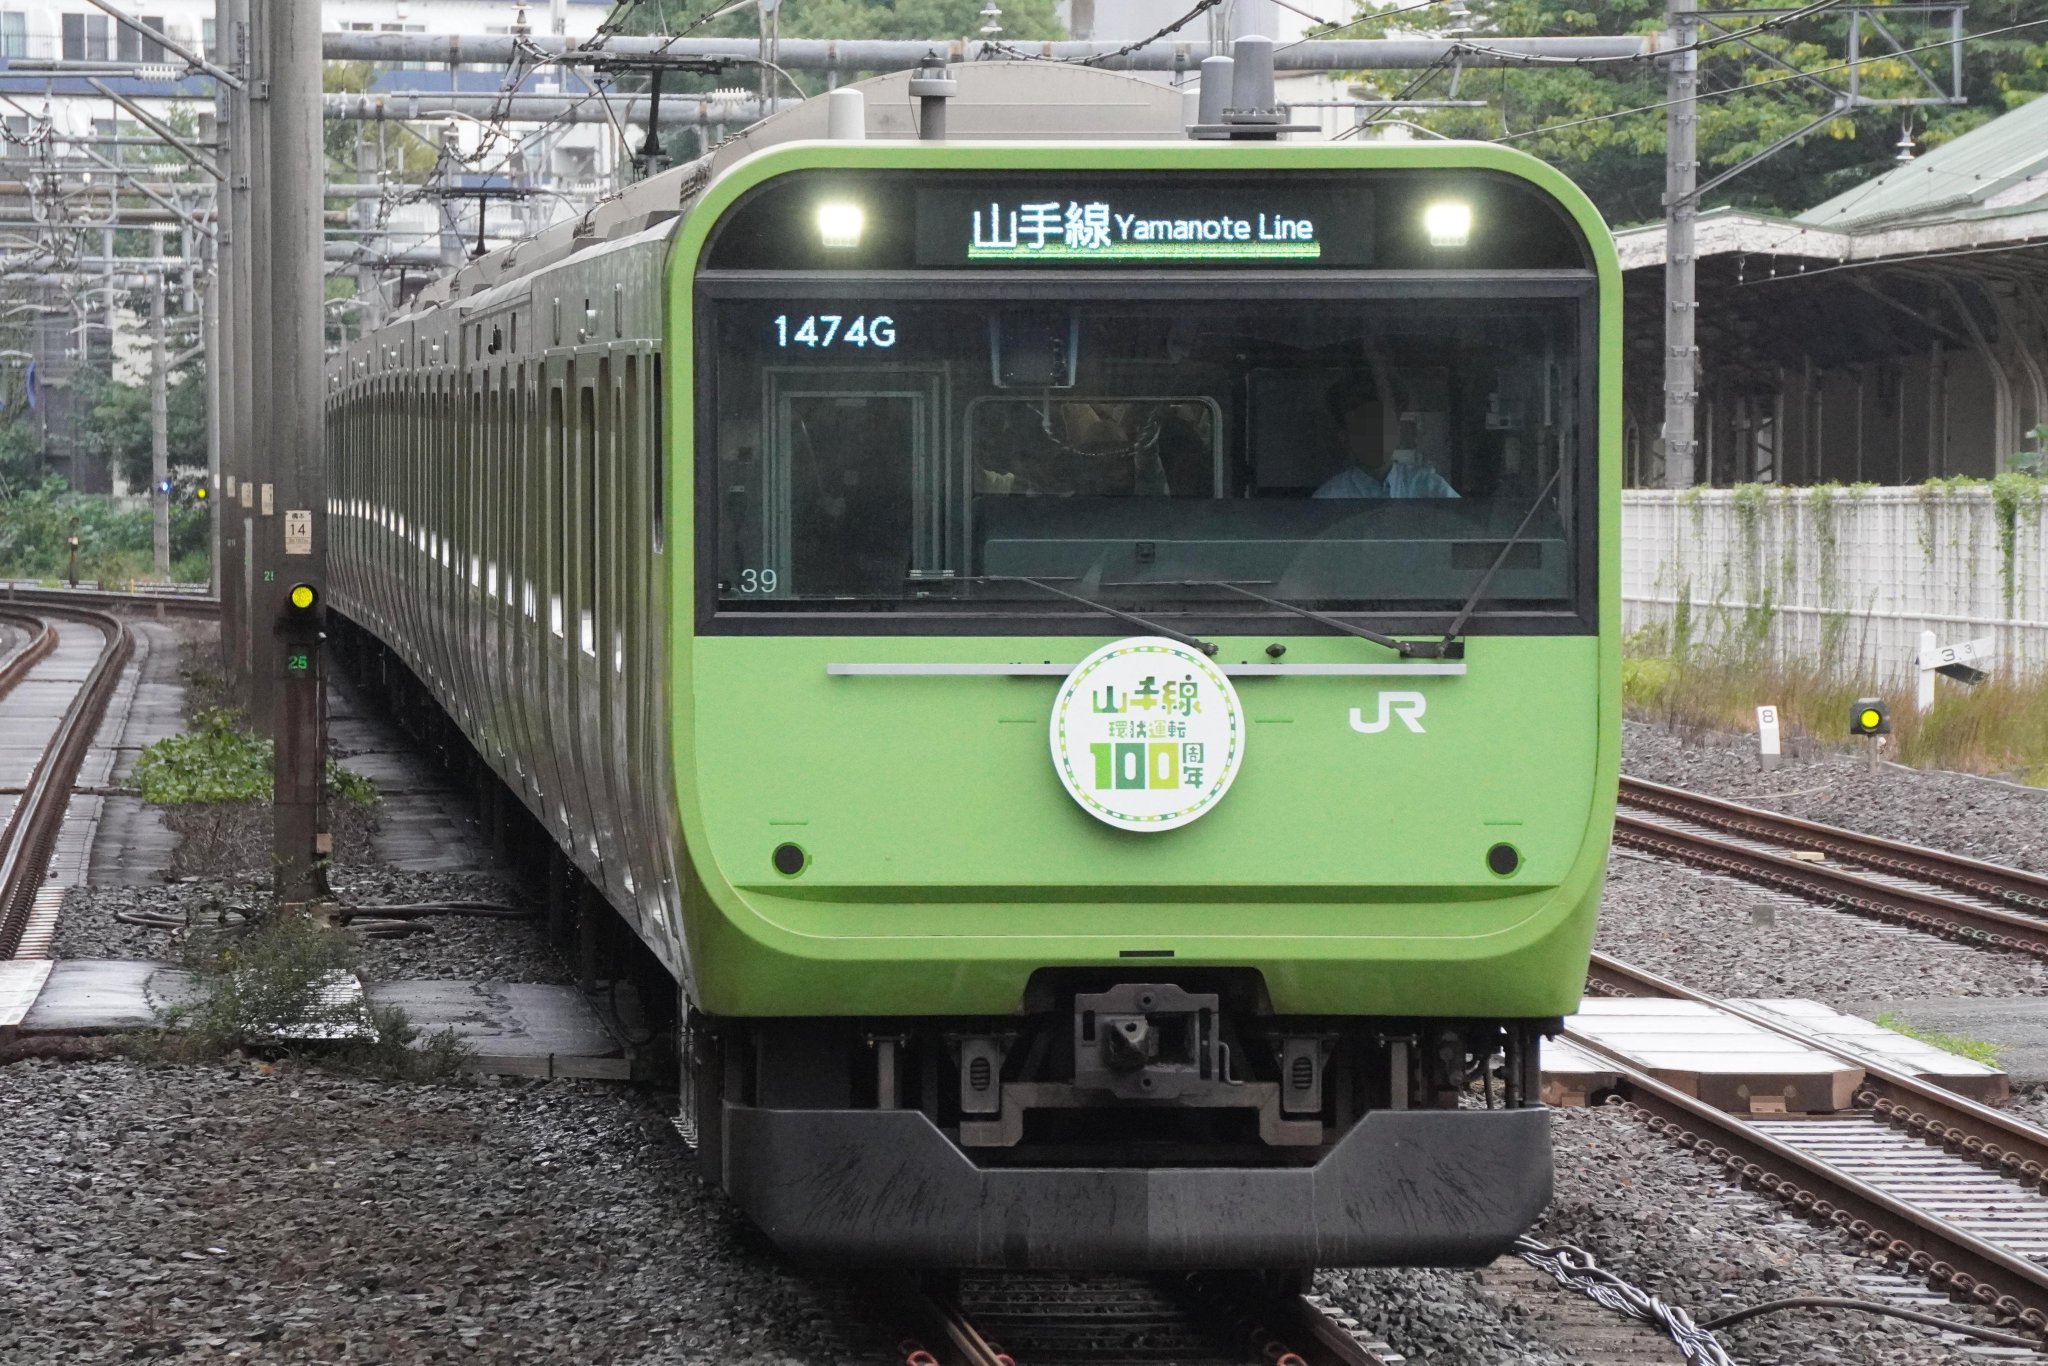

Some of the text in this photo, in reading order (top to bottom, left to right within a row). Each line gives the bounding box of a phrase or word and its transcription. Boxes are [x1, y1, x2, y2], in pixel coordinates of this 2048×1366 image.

[973, 201, 1314, 249] 山手線 Yamanote Line
[774, 314, 896, 348] 1474G
[290, 522, 306, 536] 14
[740, 568, 778, 593] 39
[287, 655, 308, 670] 25
[1092, 674, 1203, 717] 山手線
[1349, 691, 1426, 734] JR
[1762, 709, 1774, 724] 8
